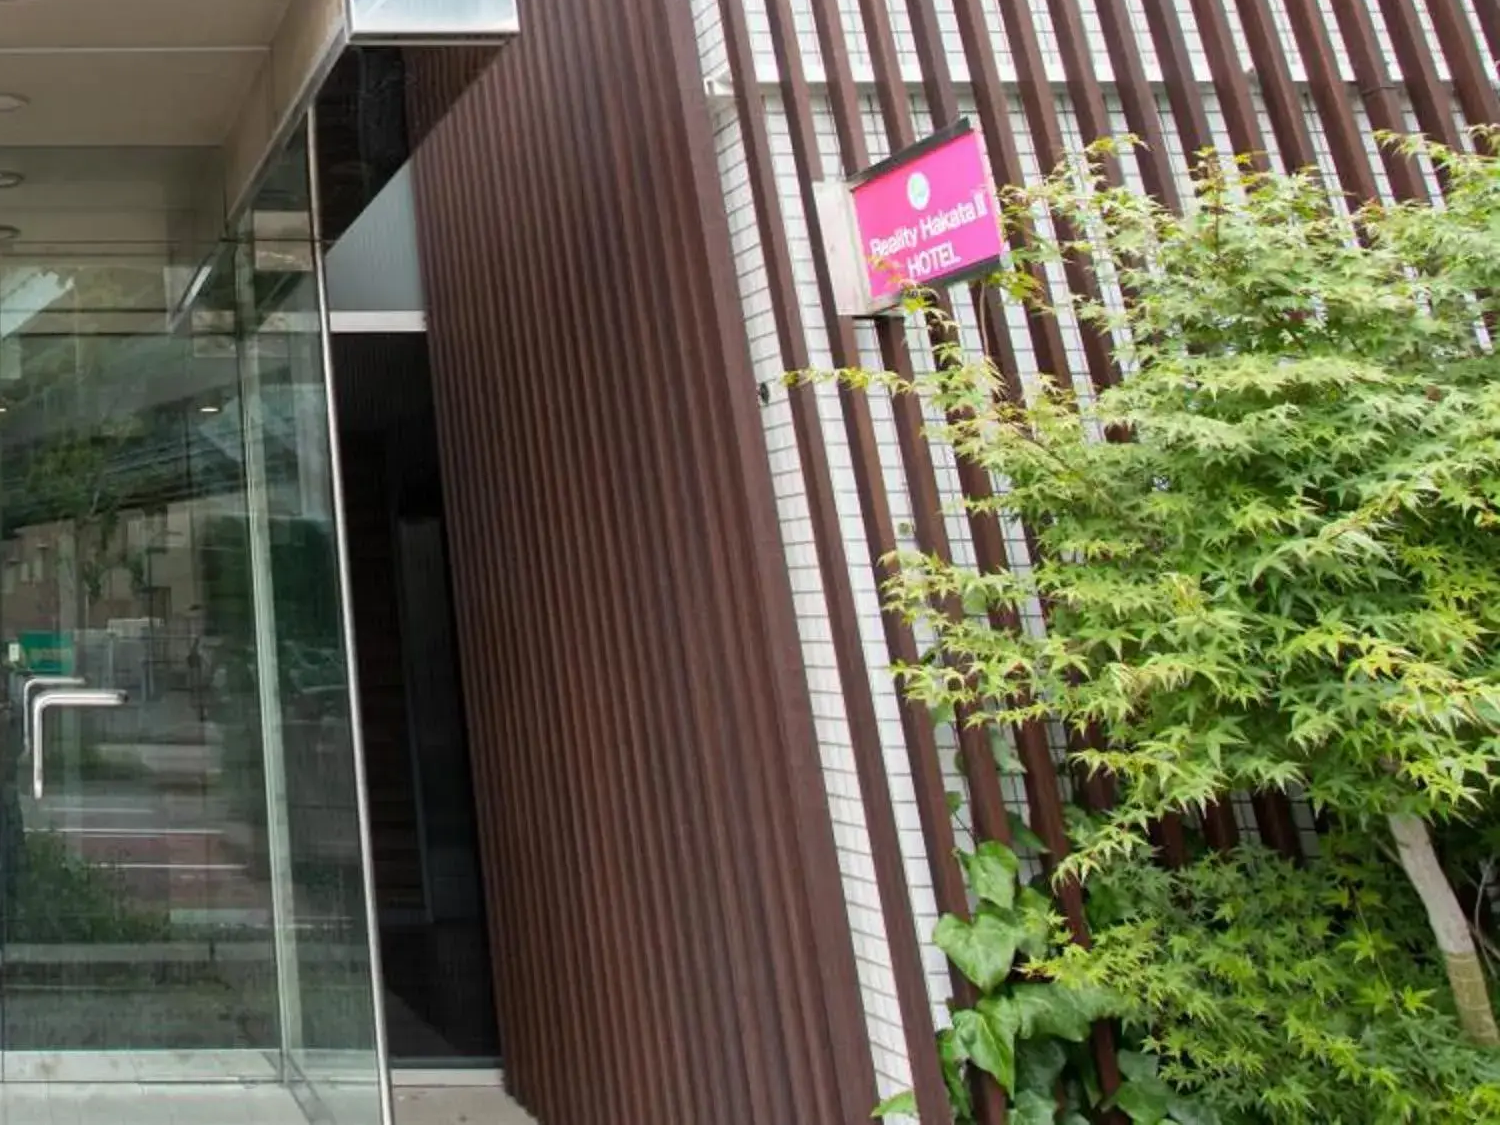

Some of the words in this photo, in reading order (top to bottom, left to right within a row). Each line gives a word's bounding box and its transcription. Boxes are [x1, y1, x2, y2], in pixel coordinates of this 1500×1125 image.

[870, 225, 918, 258] Reality
[921, 203, 975, 239] Hakata
[907, 243, 961, 278] HOTEL
